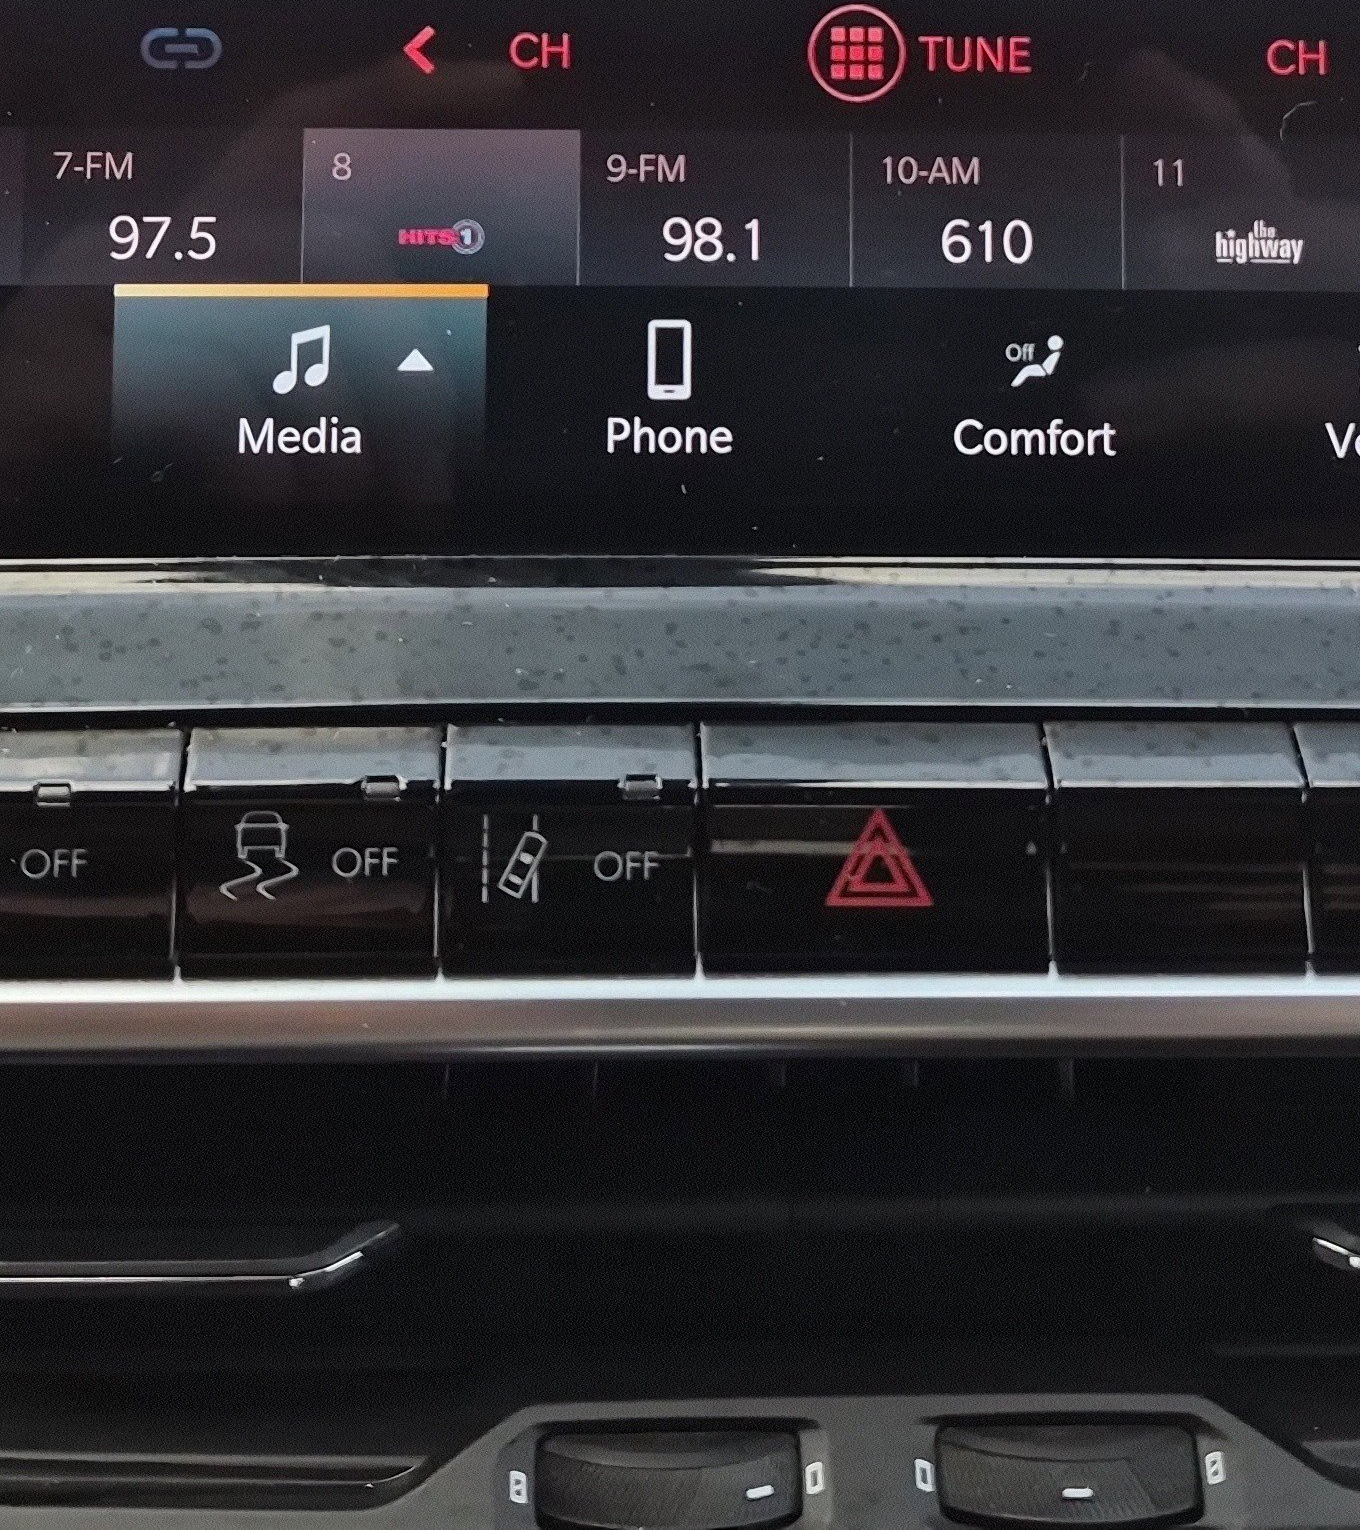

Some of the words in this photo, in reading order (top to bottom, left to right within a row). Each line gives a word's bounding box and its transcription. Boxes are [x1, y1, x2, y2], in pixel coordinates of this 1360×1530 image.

[509, 32, 571, 69] CH
[918, 35, 1031, 74] TUNE
[1266, 39, 1327, 76] CH
[54, 151, 133, 180] 7-FM
[331, 152, 352, 181] 8
[606, 153, 686, 183] 9-FM
[883, 156, 980, 185] 10-AM
[1154, 158, 1184, 187] 11
[108, 215, 217, 261] 97.5
[662, 216, 759, 262] 98.1
[941, 218, 1033, 265] 610
[1253, 219, 1277, 239] the
[1214, 228, 1304, 265] highway
[1004, 342, 1036, 363] Off
[238, 416, 362, 454] Media
[606, 416, 733, 454] Phone
[953, 418, 1116, 457] Comfort
[20, 848, 86, 880] OFF
[331, 847, 398, 879] OFF
[593, 850, 660, 882] OFF
